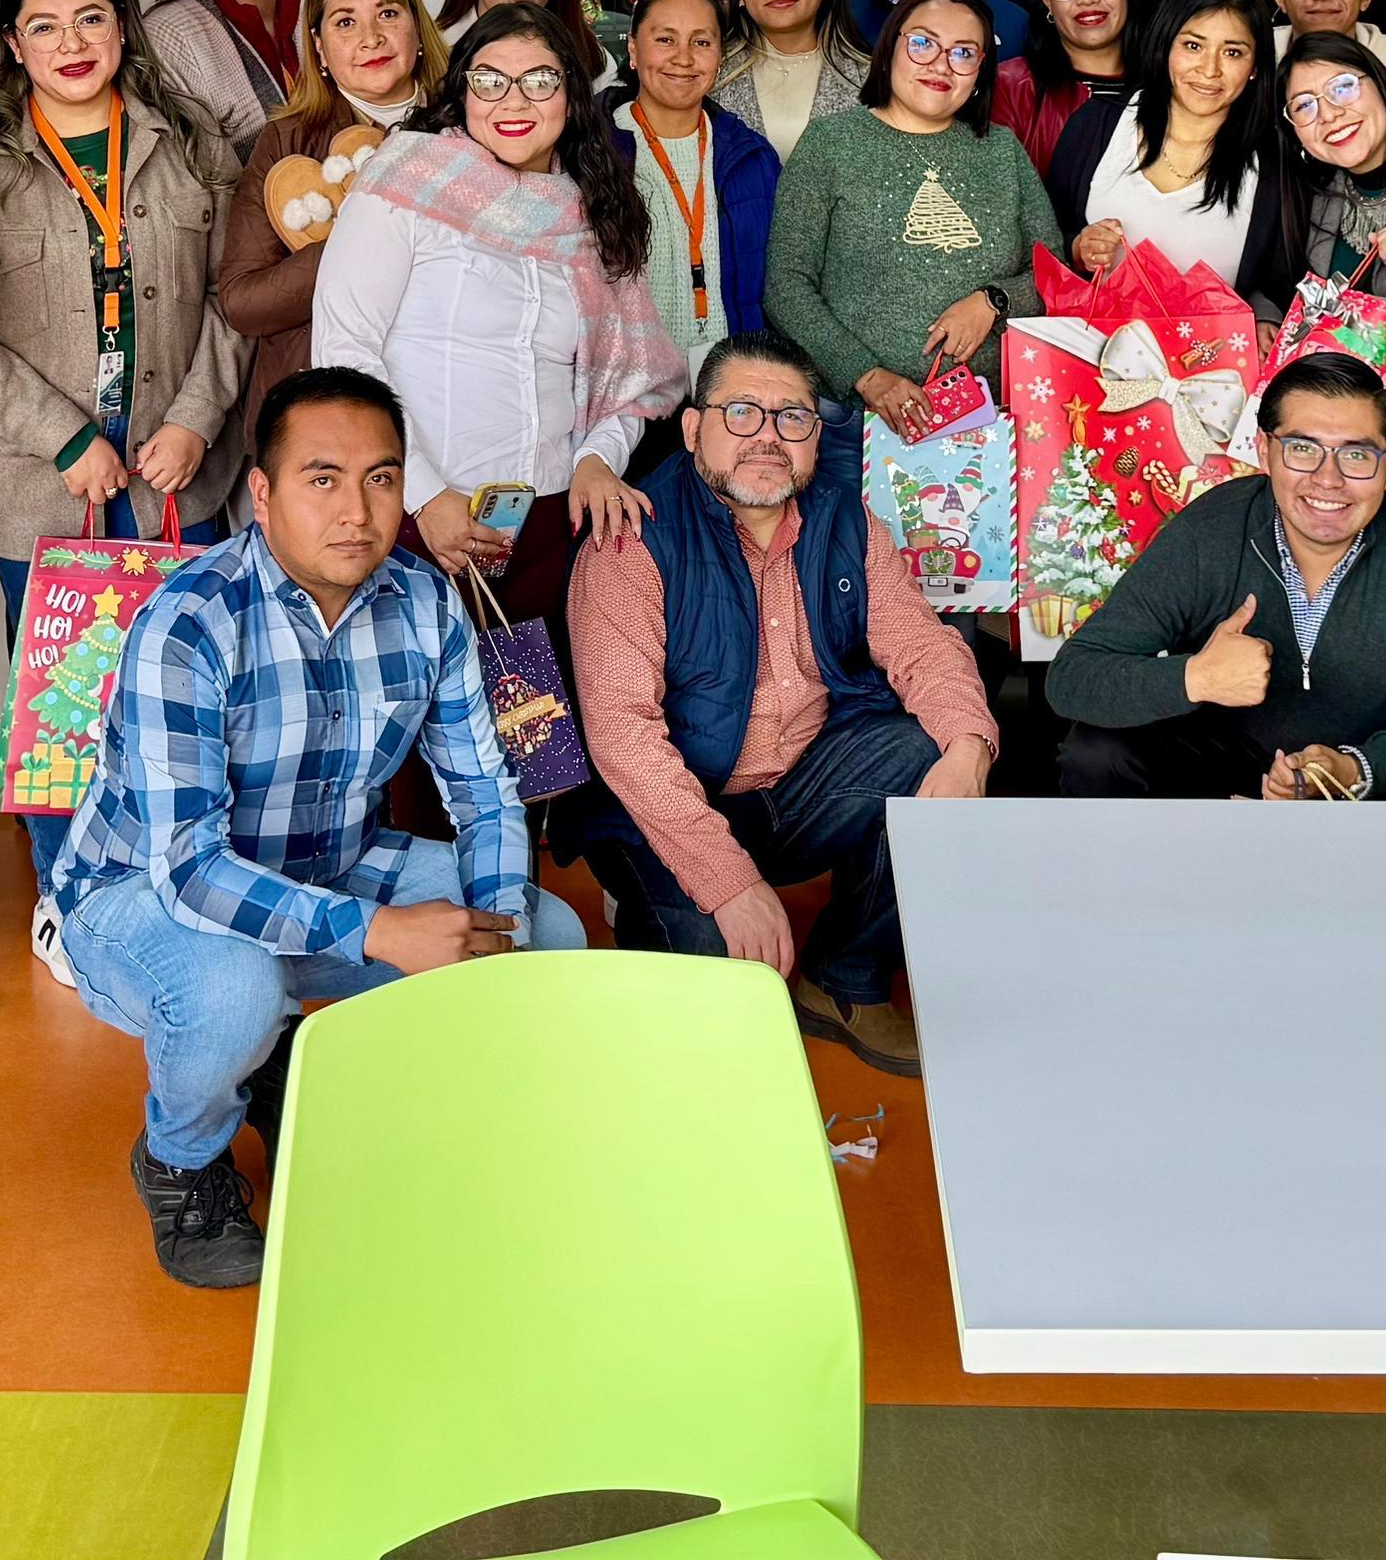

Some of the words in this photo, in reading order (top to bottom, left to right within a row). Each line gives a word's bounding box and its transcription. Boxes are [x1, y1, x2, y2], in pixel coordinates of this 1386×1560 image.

[44, 583, 87, 617] HO!
[33, 614, 73, 642] HO!
[28, 644, 59, 669] HO!
